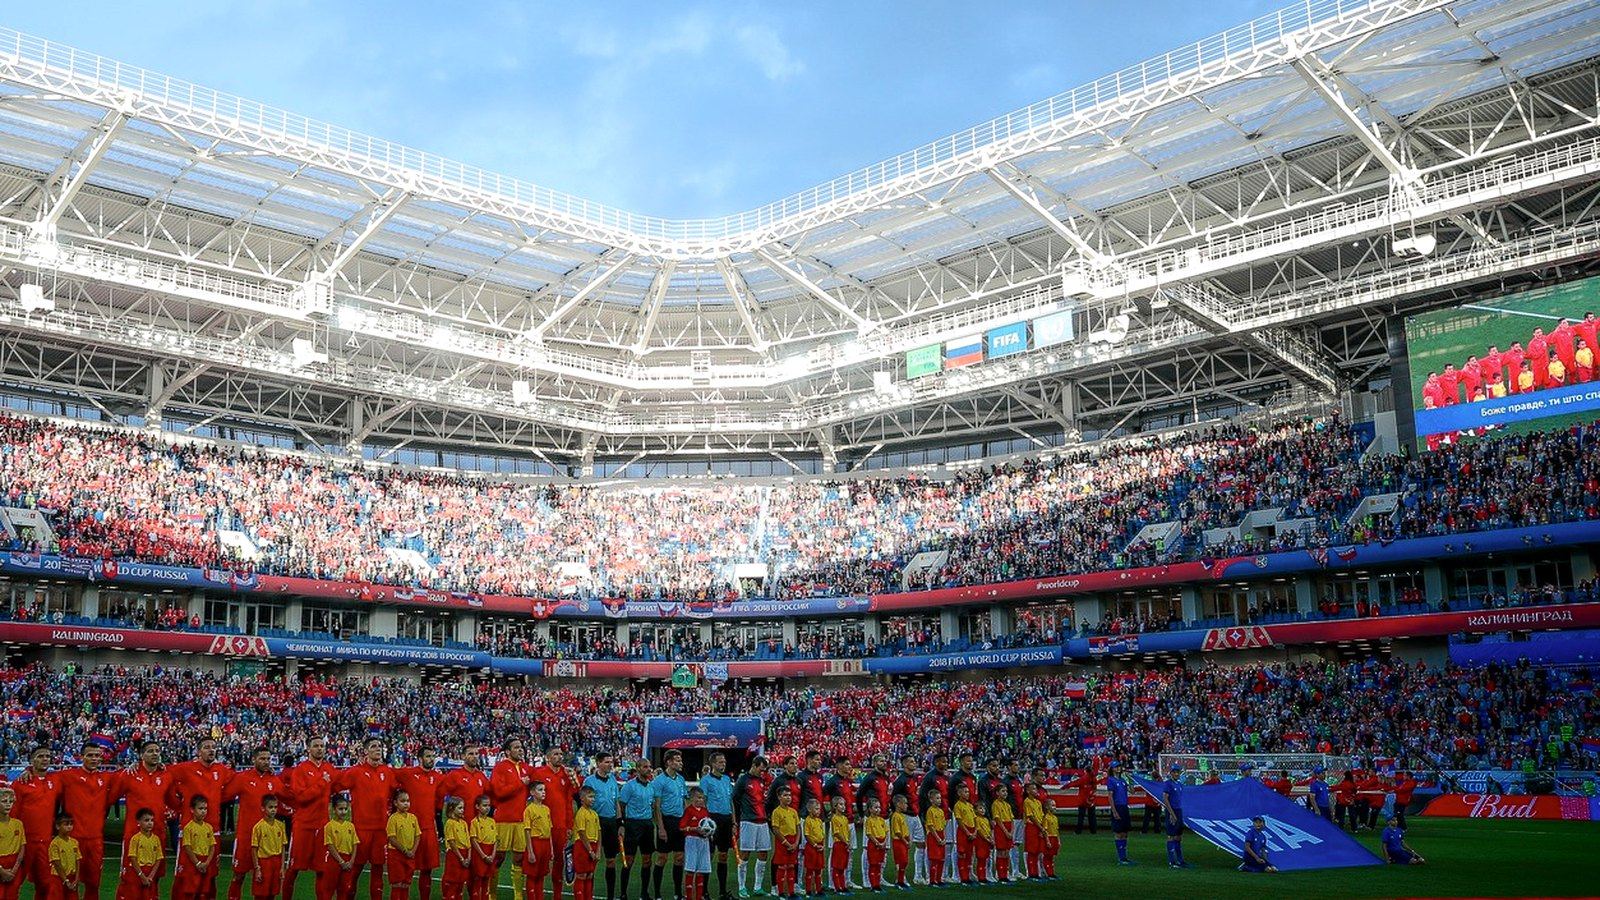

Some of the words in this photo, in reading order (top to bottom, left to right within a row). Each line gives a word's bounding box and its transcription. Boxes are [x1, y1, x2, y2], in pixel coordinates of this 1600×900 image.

[993, 333, 1020, 347] FIFA
[1480, 406, 1507, 417] Боже
[1508, 401, 1547, 413] правде,
[1548, 397, 1560, 406] ти
[1562, 395, 1583, 404] што
[131, 568, 151, 577] CUP
[152, 569, 189, 581] RUSSIA
[1036, 580, 1080, 589] #worldcup
[733, 603, 750, 612] FIFA
[752, 603, 770, 612] 2018
[778, 602, 810, 611] РОССИИ
[1468, 610, 1573, 626] КАЛИНИНГРАД
[52, 630, 124, 642] KALININGRAD
[286, 643, 334, 653] ЧЕМПИОНАТ
[336, 646, 359, 655] МИРА
[359, 647, 370, 655] ПО
[371, 648, 405, 658] ФУТБОЛУ
[406, 650, 421, 658] FIFA
[422, 650, 439, 659] 2018
[446, 652, 475, 661] РОССИИ
[929, 658, 948, 667] 2018
[948, 656, 967, 666] FIFA
[968, 653, 1000, 664] WORLD
[1000, 652, 1020, 661] CUP
[1021, 651, 1056, 661] RUSSIA
[1462, 794, 1538, 818] Bud
